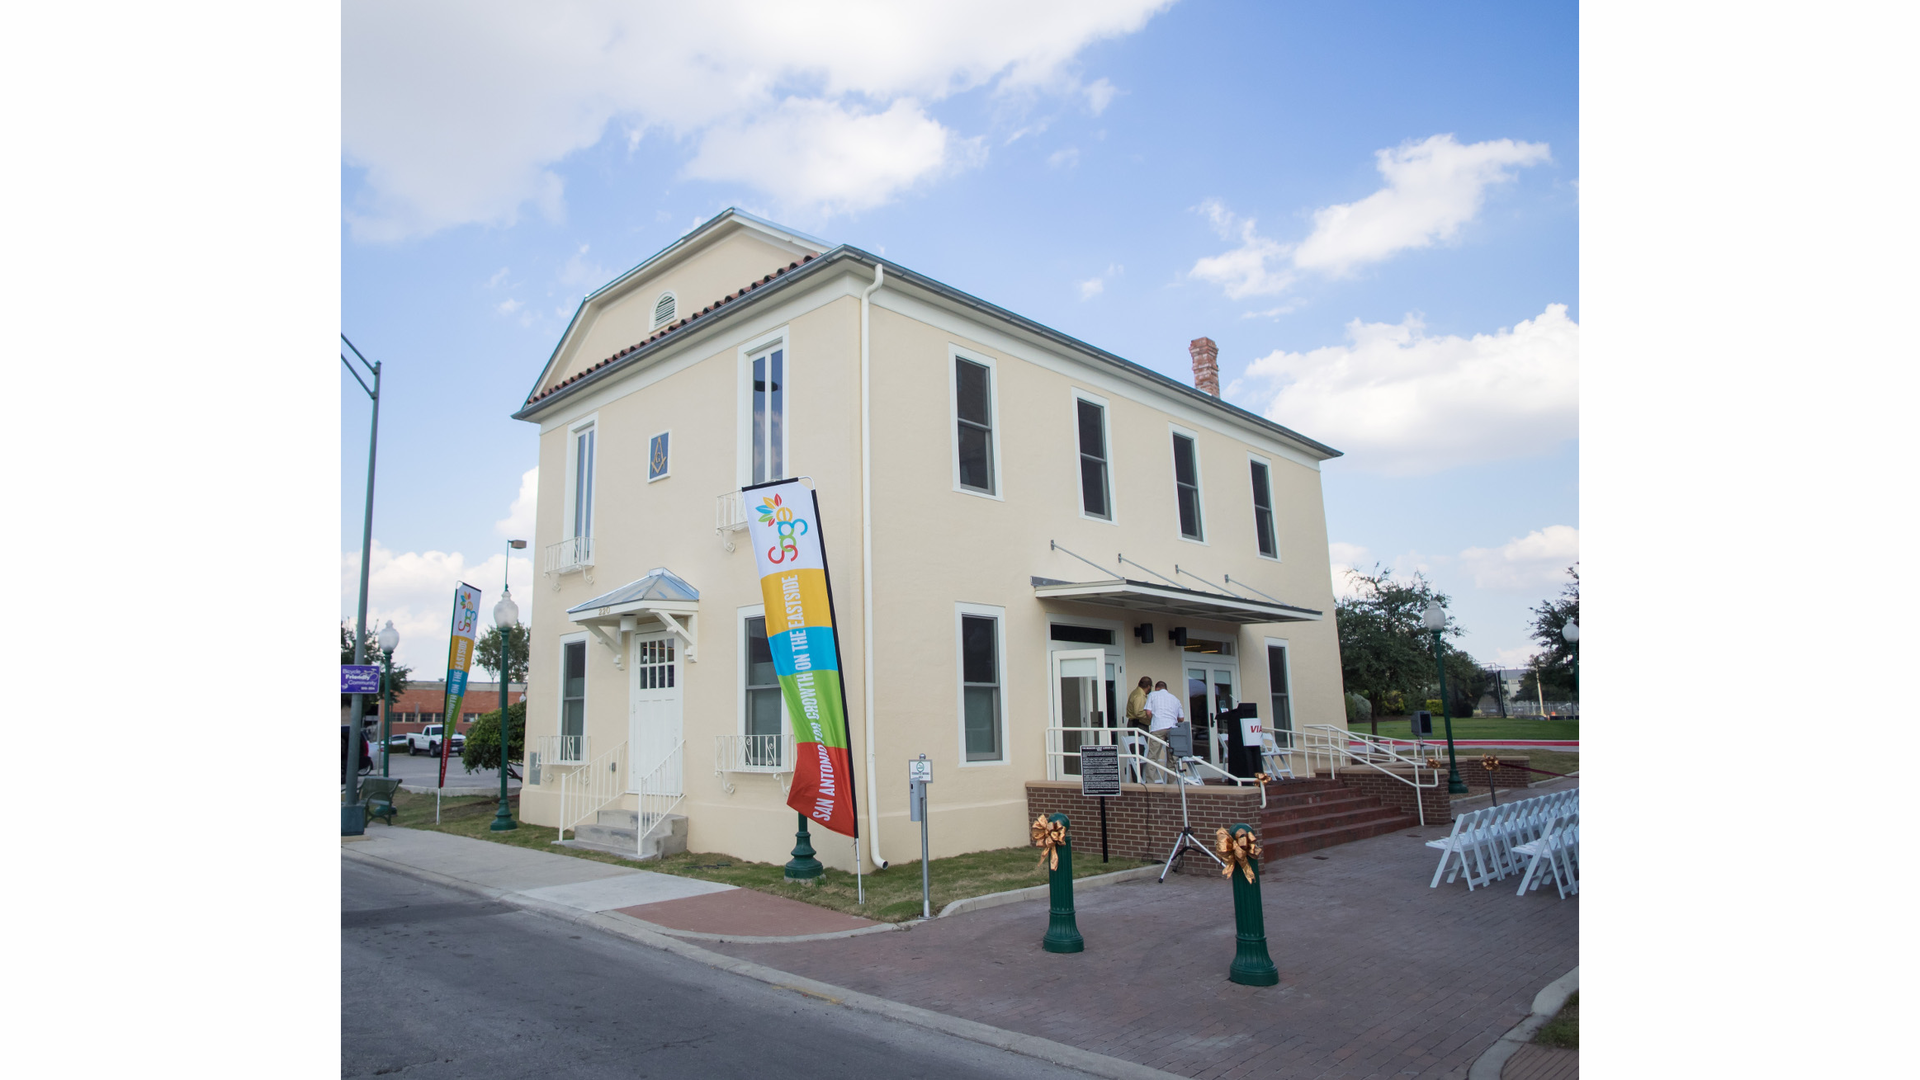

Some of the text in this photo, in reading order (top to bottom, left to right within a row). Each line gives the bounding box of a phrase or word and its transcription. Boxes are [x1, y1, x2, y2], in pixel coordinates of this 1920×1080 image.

[781, 574, 806, 629] EASTSIDE
[790, 629, 810, 652] THE
[454, 638, 468, 670] EASTSIDE
[794, 655, 812, 671] ON
[345, 673, 370, 681] Friendly
[452, 670, 463, 683] THE
[450, 683, 460, 694] ON
[796, 672, 820, 720] GROWTH
[1250, 725, 1263, 733] VIA
[816, 743, 836, 797] ANTONIO
[812, 797, 835, 822] SAN
